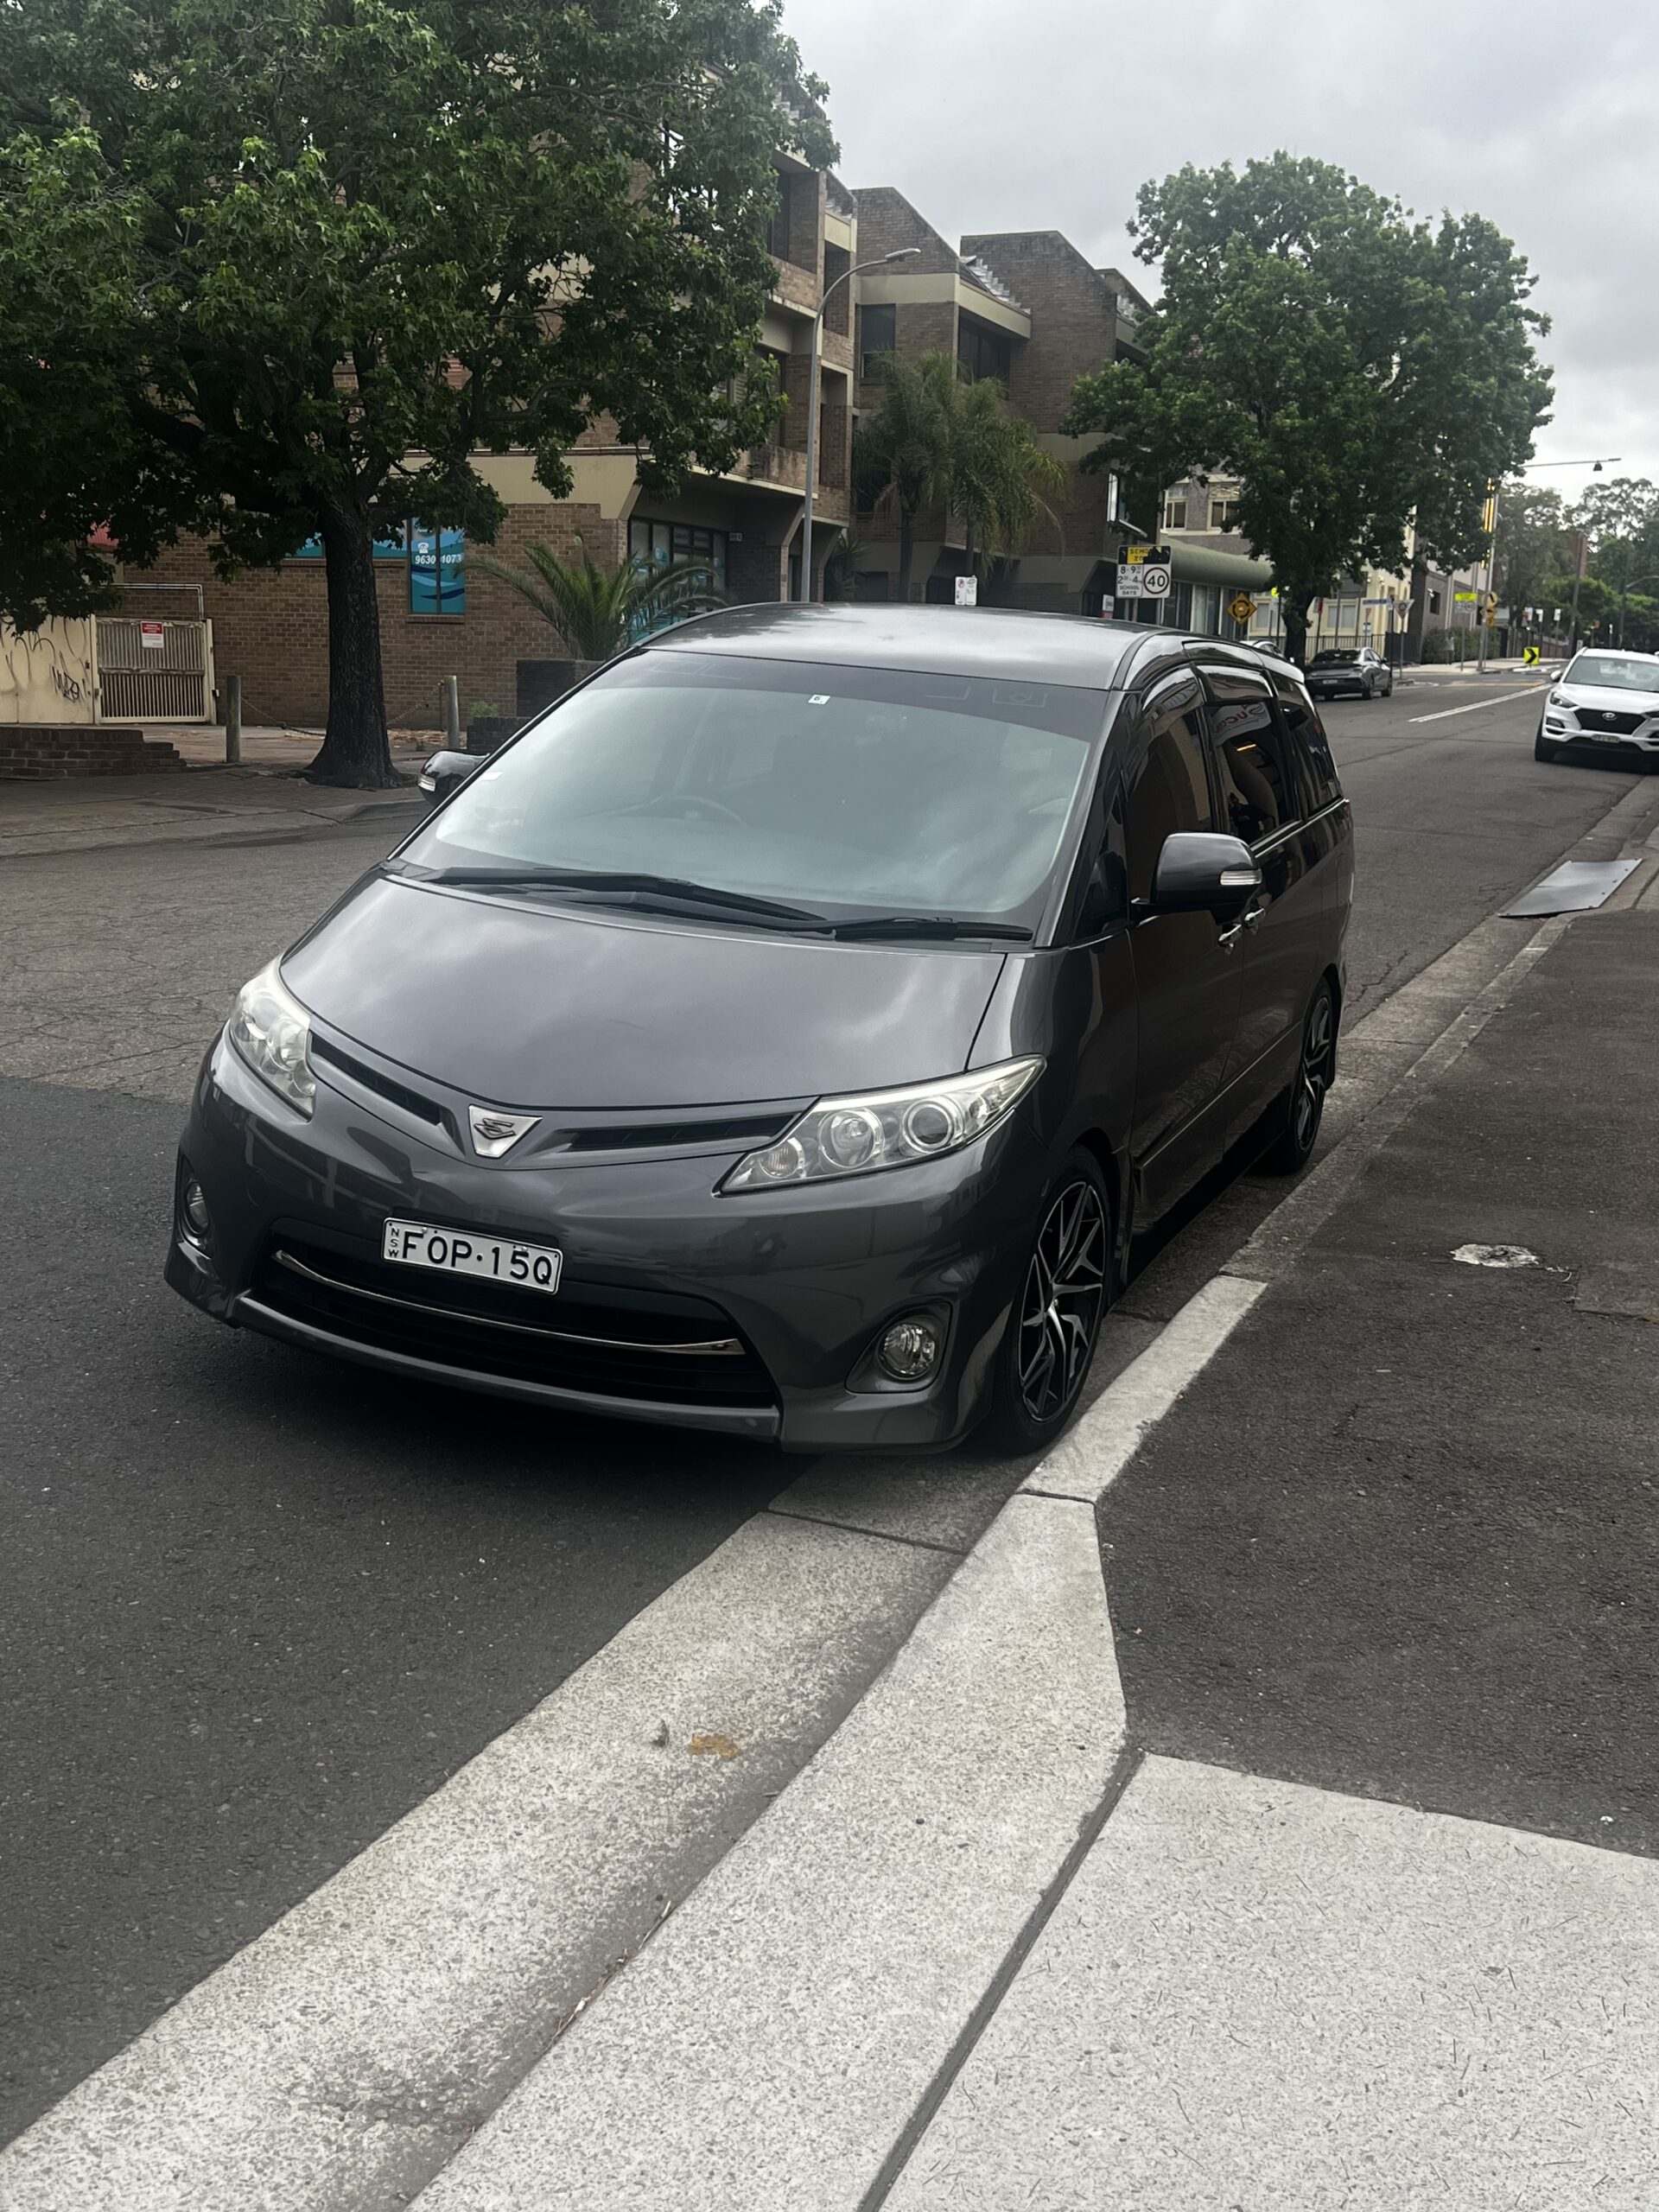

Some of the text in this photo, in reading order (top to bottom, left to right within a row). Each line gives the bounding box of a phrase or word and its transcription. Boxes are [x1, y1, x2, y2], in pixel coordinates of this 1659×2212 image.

[415, 554, 462, 564] 9630 1073
[1147, 575, 1166, 587] 40
[388, 1227, 400, 1258] NSW
